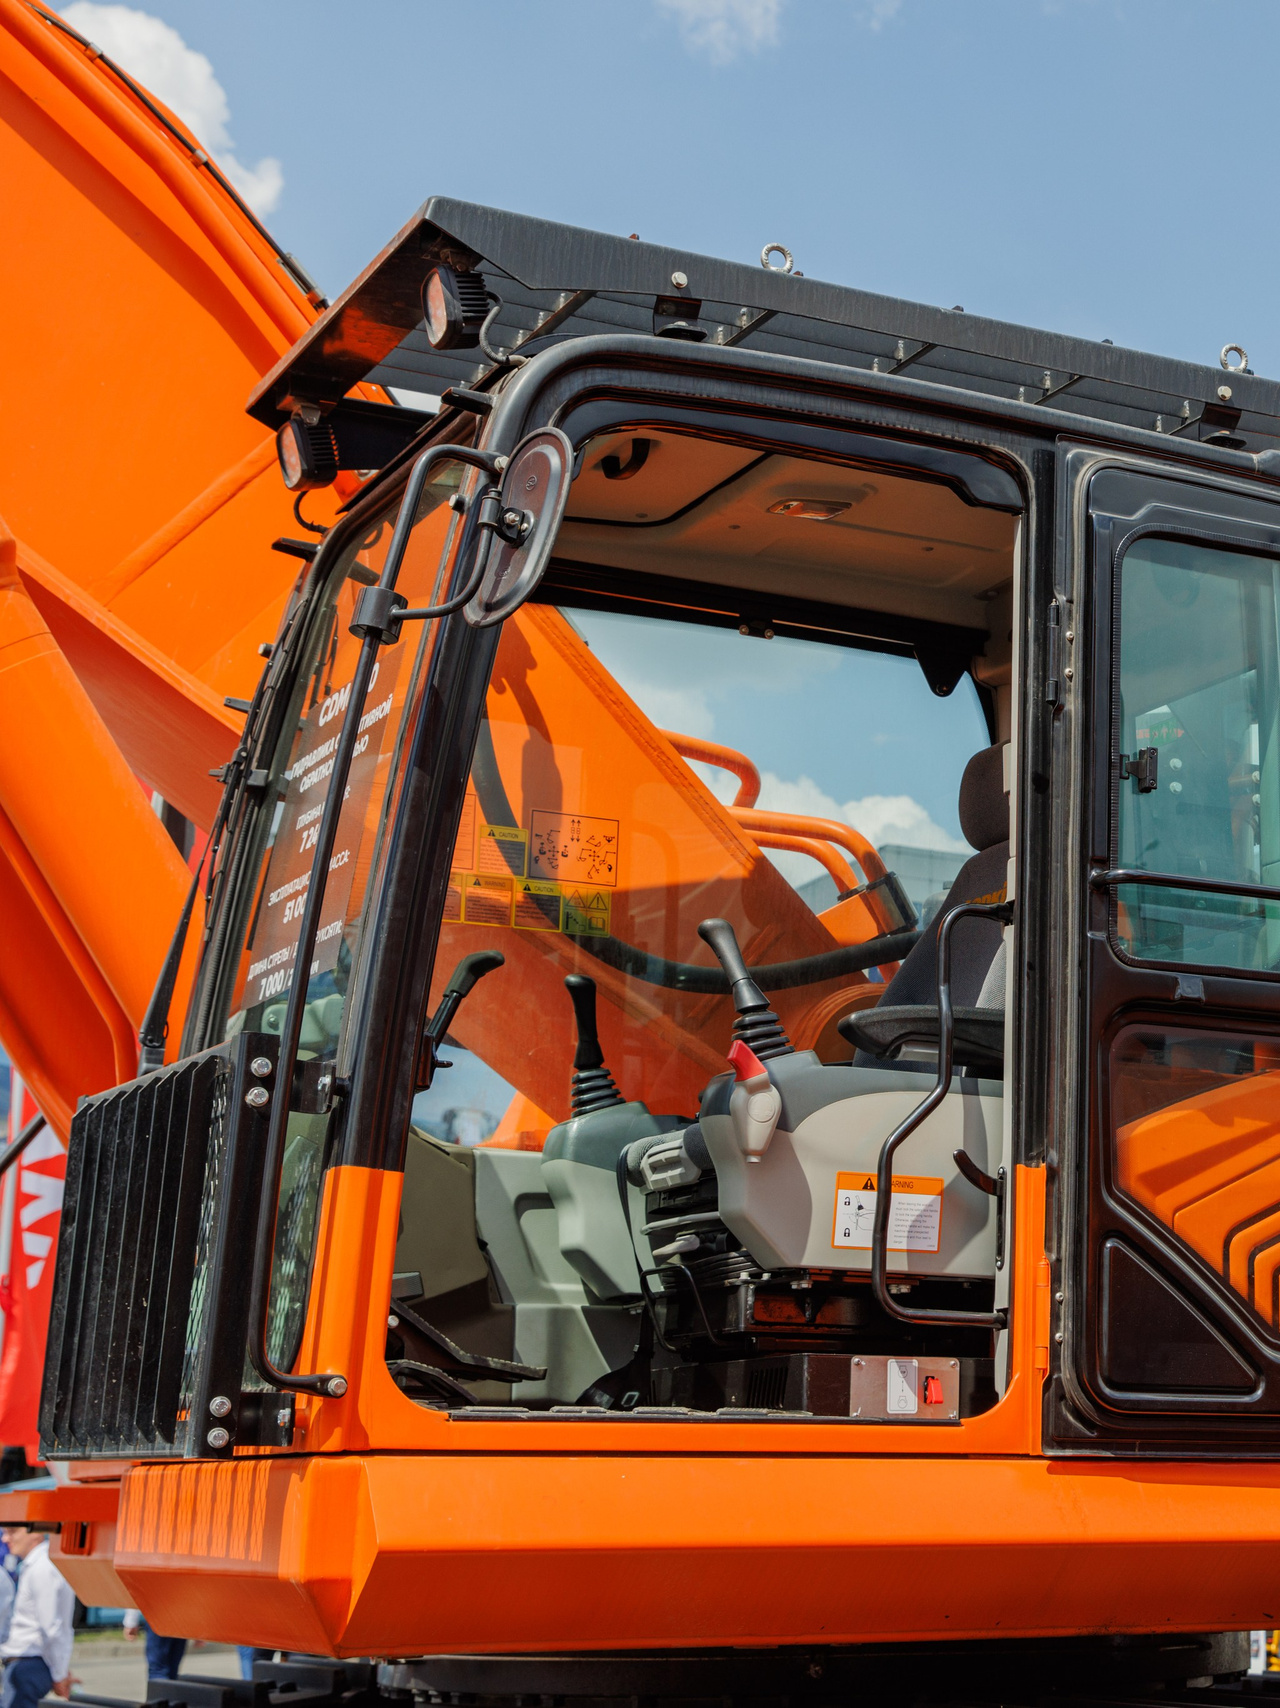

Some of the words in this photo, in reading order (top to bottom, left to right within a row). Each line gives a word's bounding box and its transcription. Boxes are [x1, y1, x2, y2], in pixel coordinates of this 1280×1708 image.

[318, 662, 380, 727] CDM0
[357, 693, 393, 734] ТИВНОЙ
[499, 831, 519, 839] CAUTION
[534, 885, 554, 893] CAUTION
[294, 892, 307, 918] 00
[891, 1180, 914, 1189] ARNING
